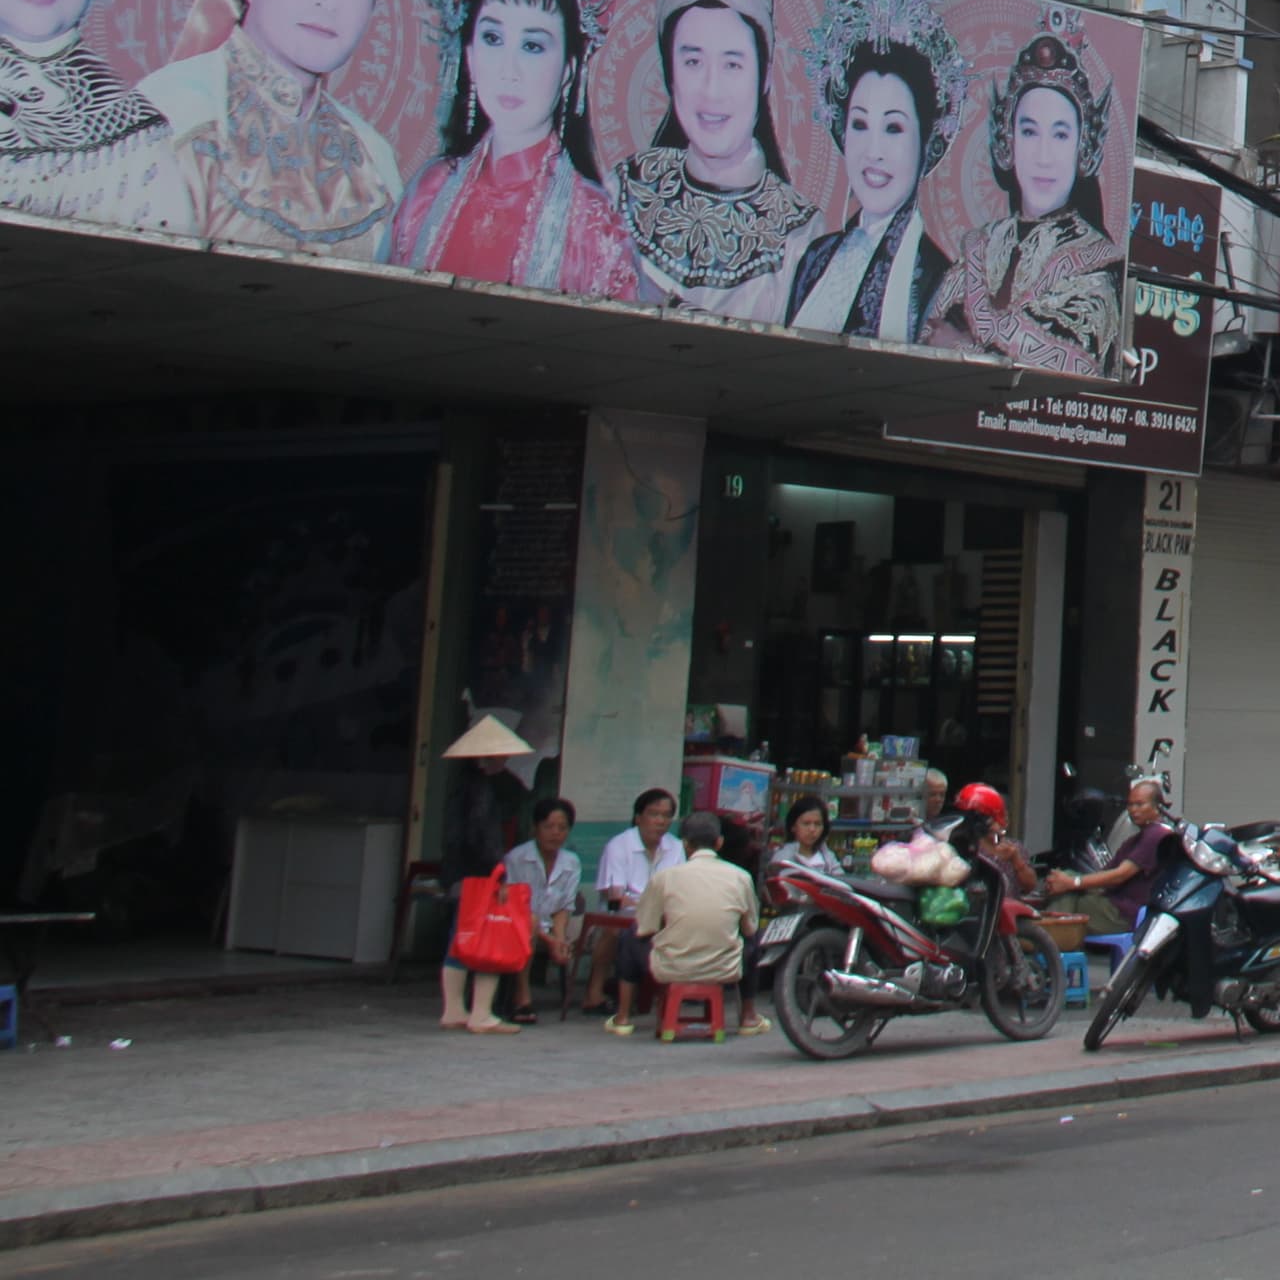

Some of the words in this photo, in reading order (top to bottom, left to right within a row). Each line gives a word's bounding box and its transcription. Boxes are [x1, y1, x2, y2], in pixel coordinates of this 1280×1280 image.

[1149, 201, 1204, 252] Nghệ
[977, 410, 1007, 431] Email:
[1046, 396, 1064, 416] Tel:
[1065, 400, 1089, 420] 0913
[1090, 403, 1108, 423] 424
[1110, 406, 1129, 424] 467
[1151, 411, 1173, 431] 3914
[1175, 414, 1197, 433] 6424
[725, 474, 743, 497] 19
[1159, 480, 1182, 512] 21
[1148, 567, 1181, 713] BLACK
